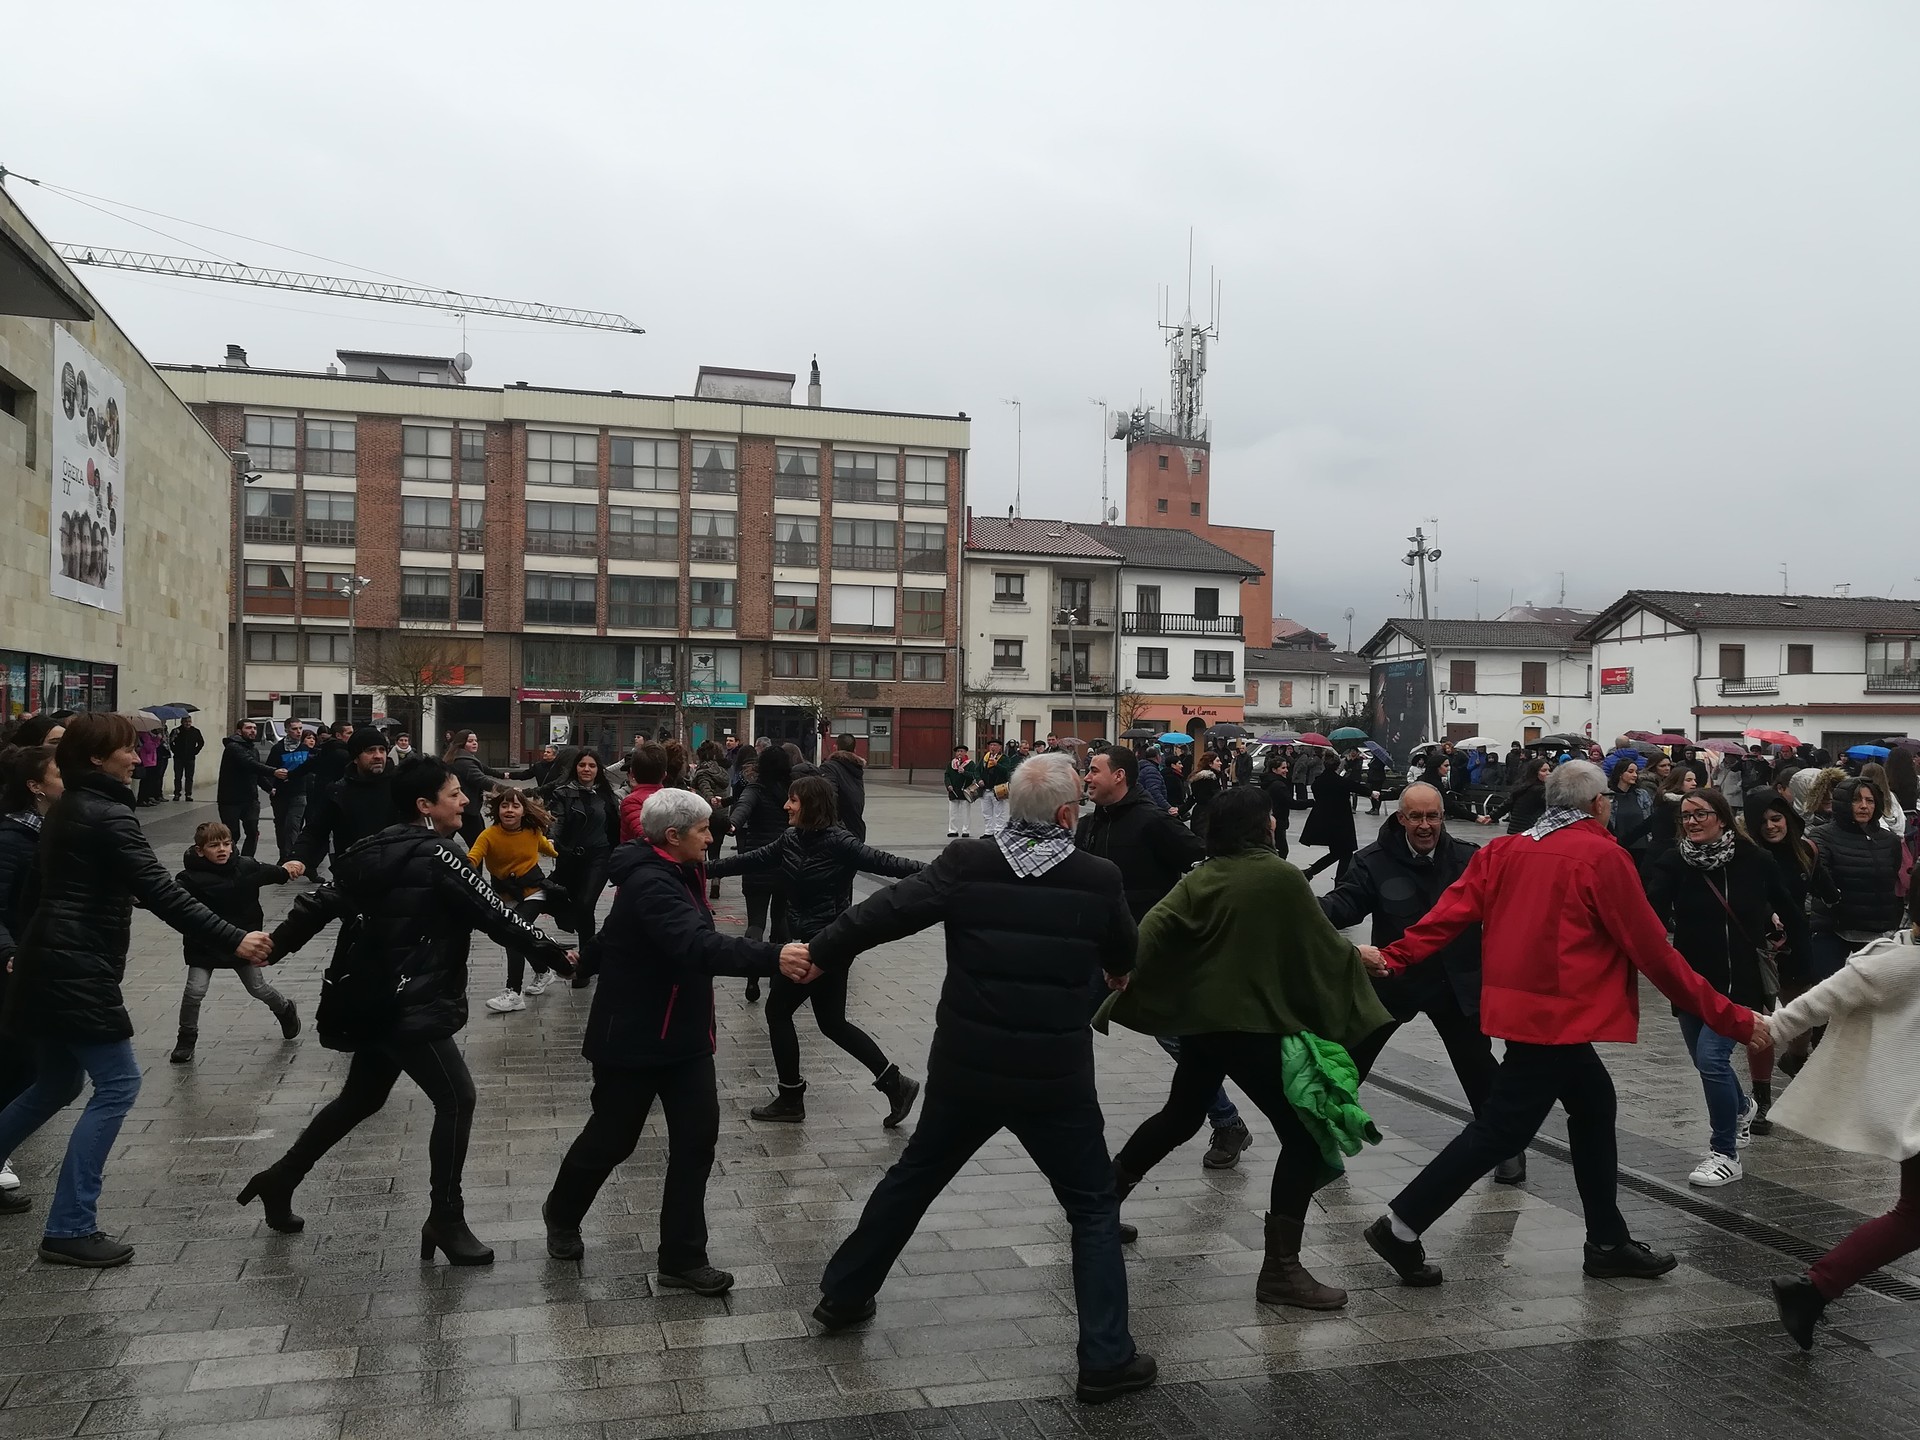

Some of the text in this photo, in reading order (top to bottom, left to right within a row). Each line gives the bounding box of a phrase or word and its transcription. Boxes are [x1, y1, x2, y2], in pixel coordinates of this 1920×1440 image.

[63, 460, 85, 486] OREKA
[62, 477, 71, 496] TX
[1197, 706, 1217, 716] Carmen
[1531, 702, 1545, 711] DYA
[460, 866, 512, 918] CURRENT
